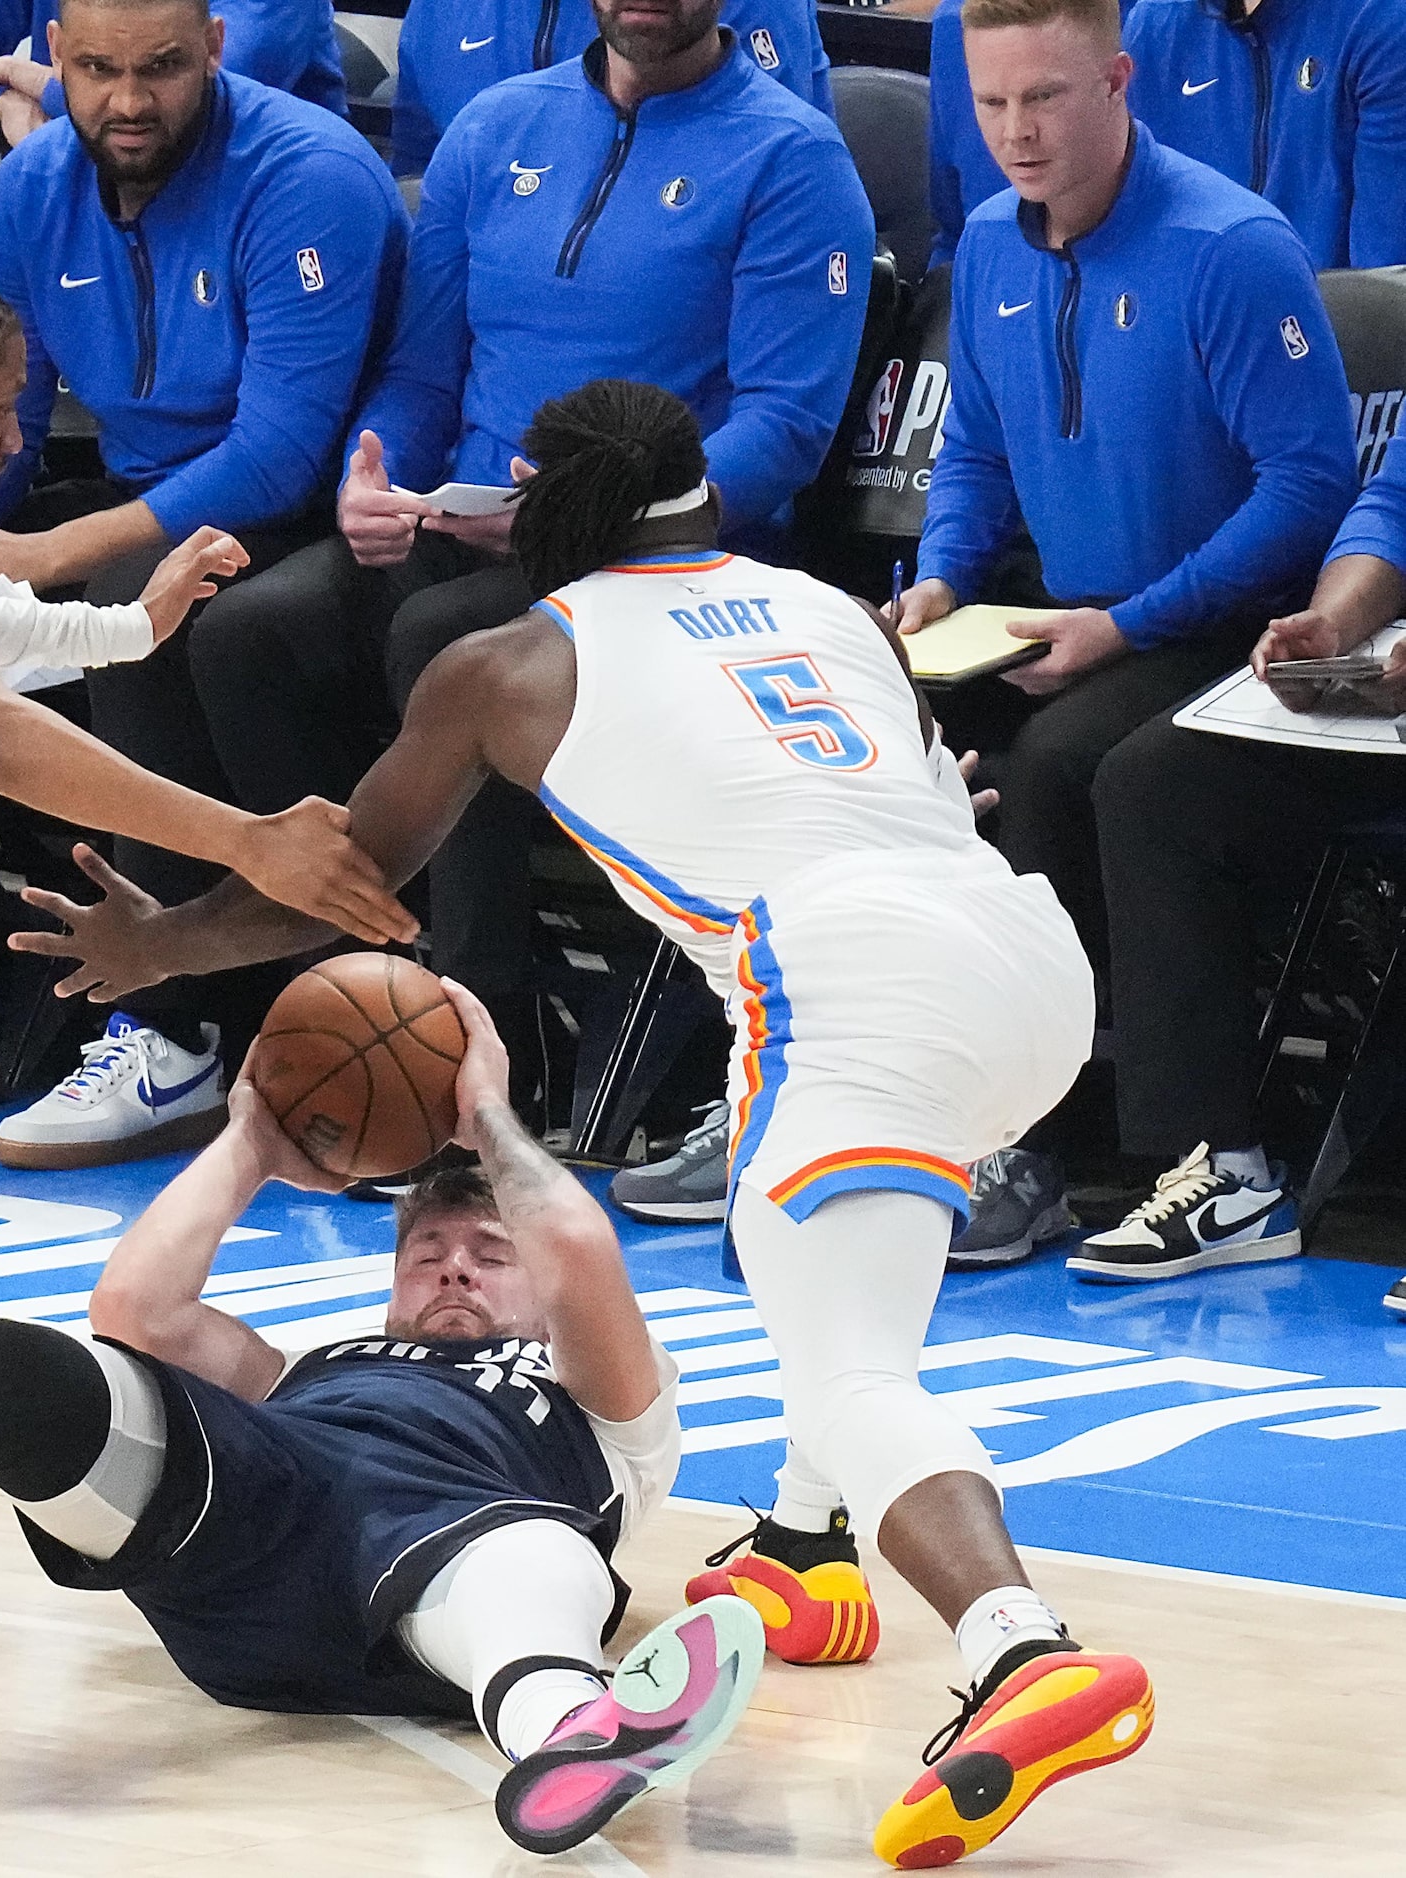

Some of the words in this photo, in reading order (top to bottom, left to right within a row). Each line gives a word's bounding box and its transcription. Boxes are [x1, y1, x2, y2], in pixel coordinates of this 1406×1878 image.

[892, 466, 908, 492] by
[667, 597, 780, 640] DORT
[718, 652, 879, 773] 5
